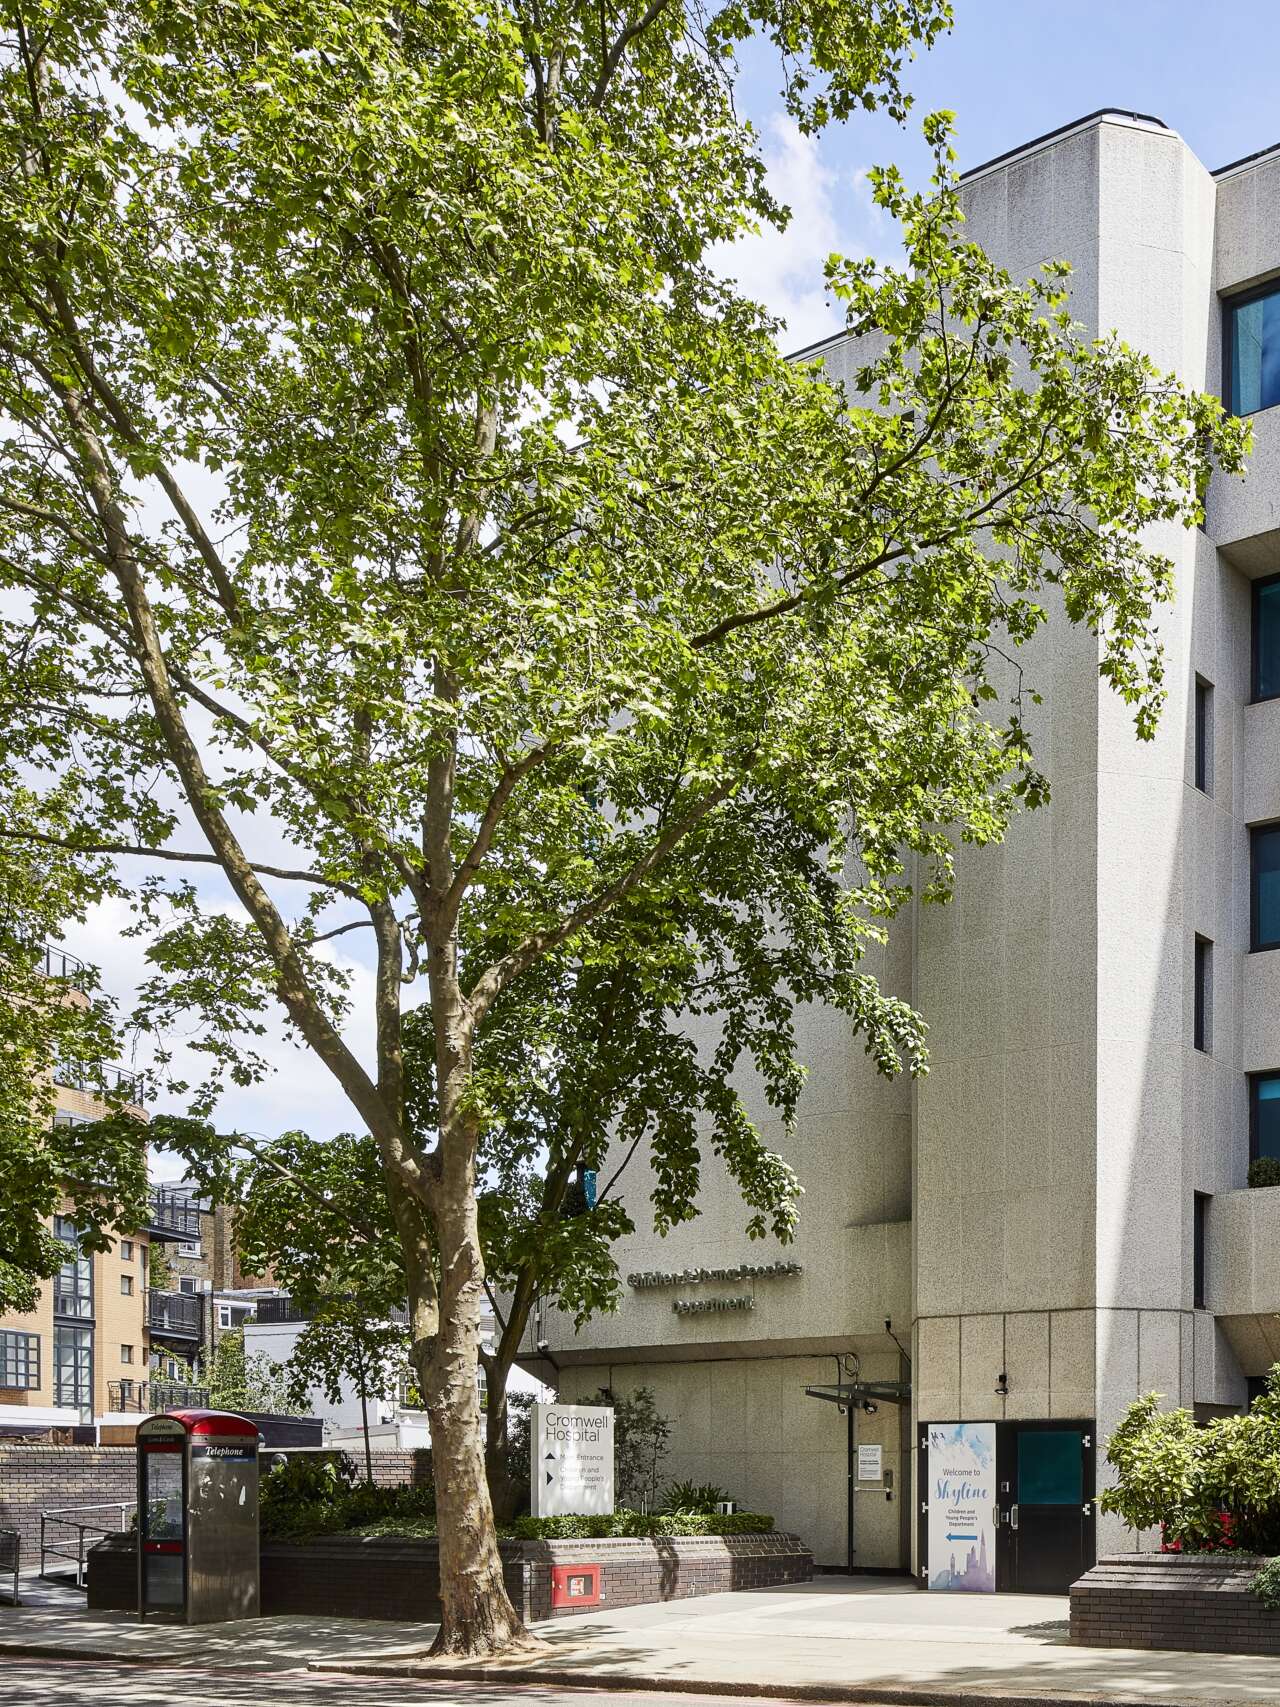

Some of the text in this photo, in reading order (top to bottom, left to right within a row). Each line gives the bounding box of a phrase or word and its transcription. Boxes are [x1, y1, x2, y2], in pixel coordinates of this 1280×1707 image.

[627, 1270, 680, 1289] Children
[694, 1266, 738, 1285] Young
[672, 1296, 754, 1315] Department
[546, 1412, 608, 1429] Cromwell
[546, 1427, 600, 1442] Hospital
[205, 1446, 243, 1457] Telephone
[577, 1453, 604, 1461] Entrance
[943, 1468, 972, 1476] Welcome
[936, 1479, 988, 1506] Skyline
